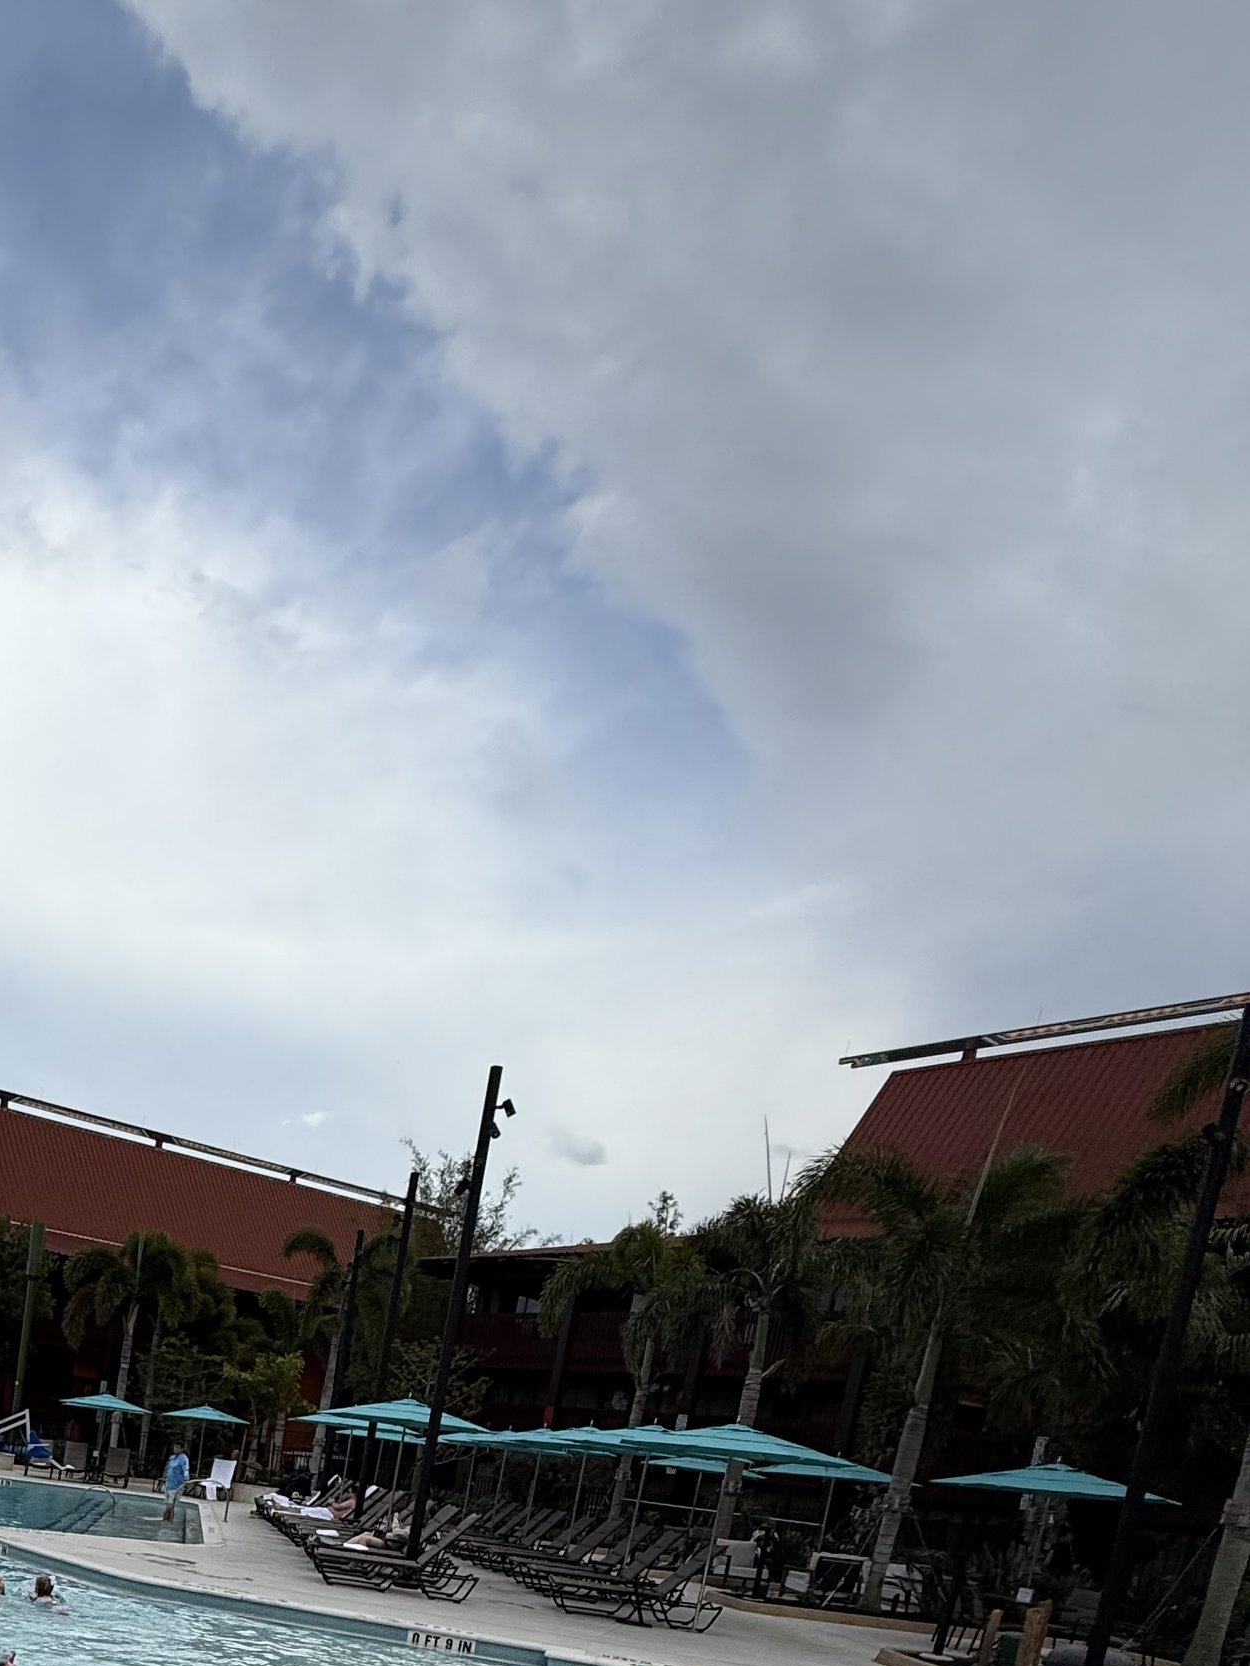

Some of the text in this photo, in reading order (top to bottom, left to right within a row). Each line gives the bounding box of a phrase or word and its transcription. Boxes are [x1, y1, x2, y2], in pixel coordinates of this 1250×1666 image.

[412, 1632, 472, 1653] 0 FT 9 IN
